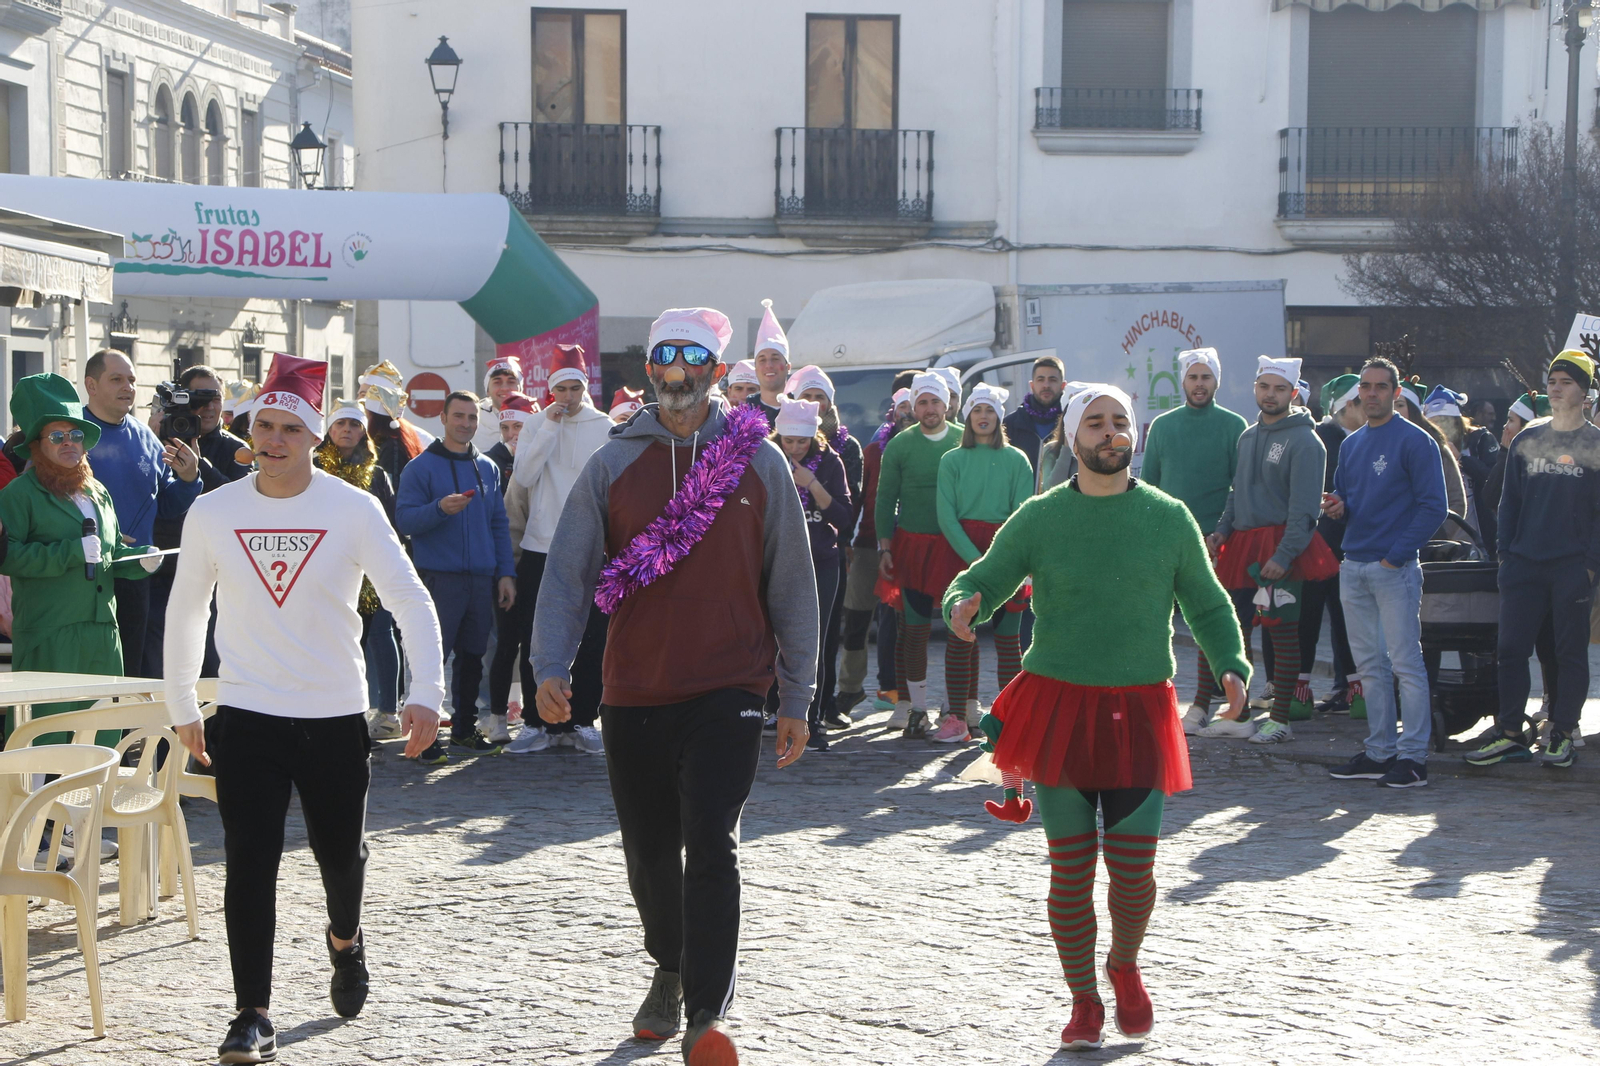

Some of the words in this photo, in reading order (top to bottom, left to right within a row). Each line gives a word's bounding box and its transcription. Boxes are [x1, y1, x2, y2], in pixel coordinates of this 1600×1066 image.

[194, 201, 260, 227] frutas
[196, 228, 332, 268] ISABEL
[1121, 309, 1203, 355] HINCHABLES
[1526, 457, 1584, 478] ellesse
[248, 535, 309, 552] GUESS
